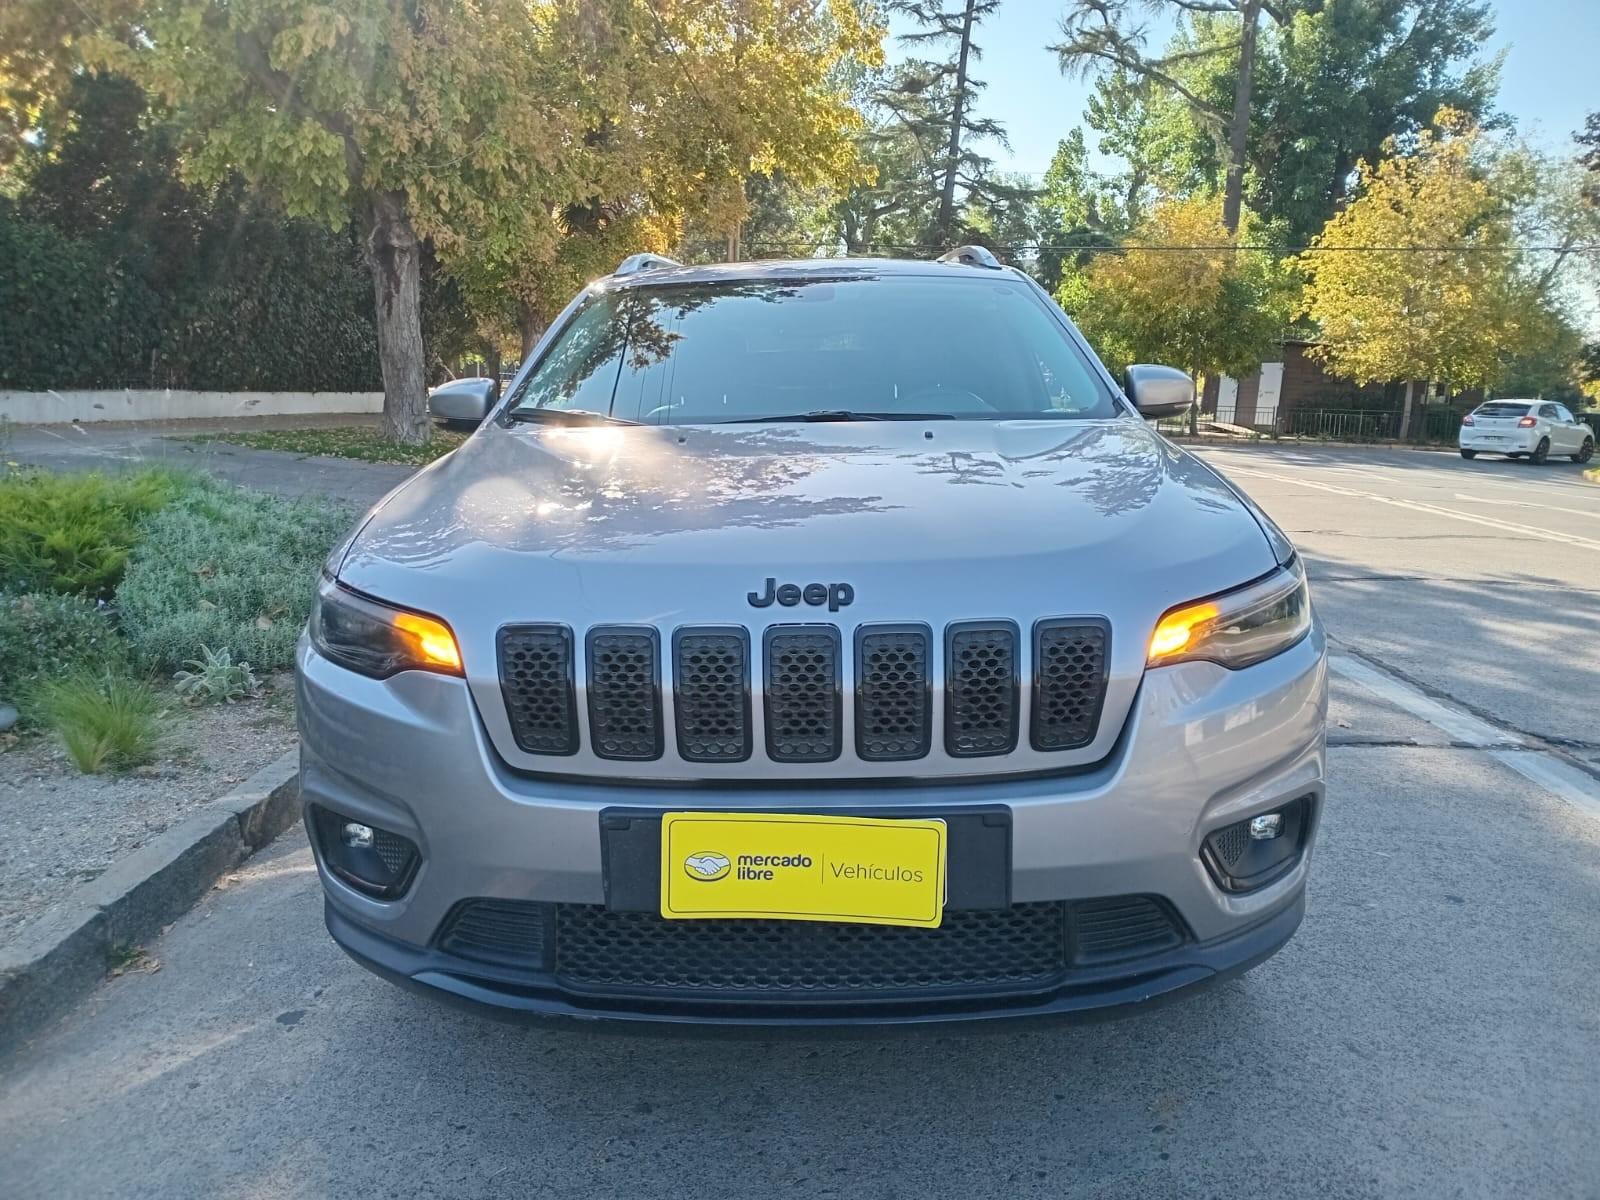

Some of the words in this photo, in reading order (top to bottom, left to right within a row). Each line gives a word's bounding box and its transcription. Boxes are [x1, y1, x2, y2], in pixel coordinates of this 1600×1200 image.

[747, 577, 855, 612] Jeep
[737, 854, 812, 868] mercado
[737, 867, 774, 881] libre
[830, 862, 924, 883] Vehículos
